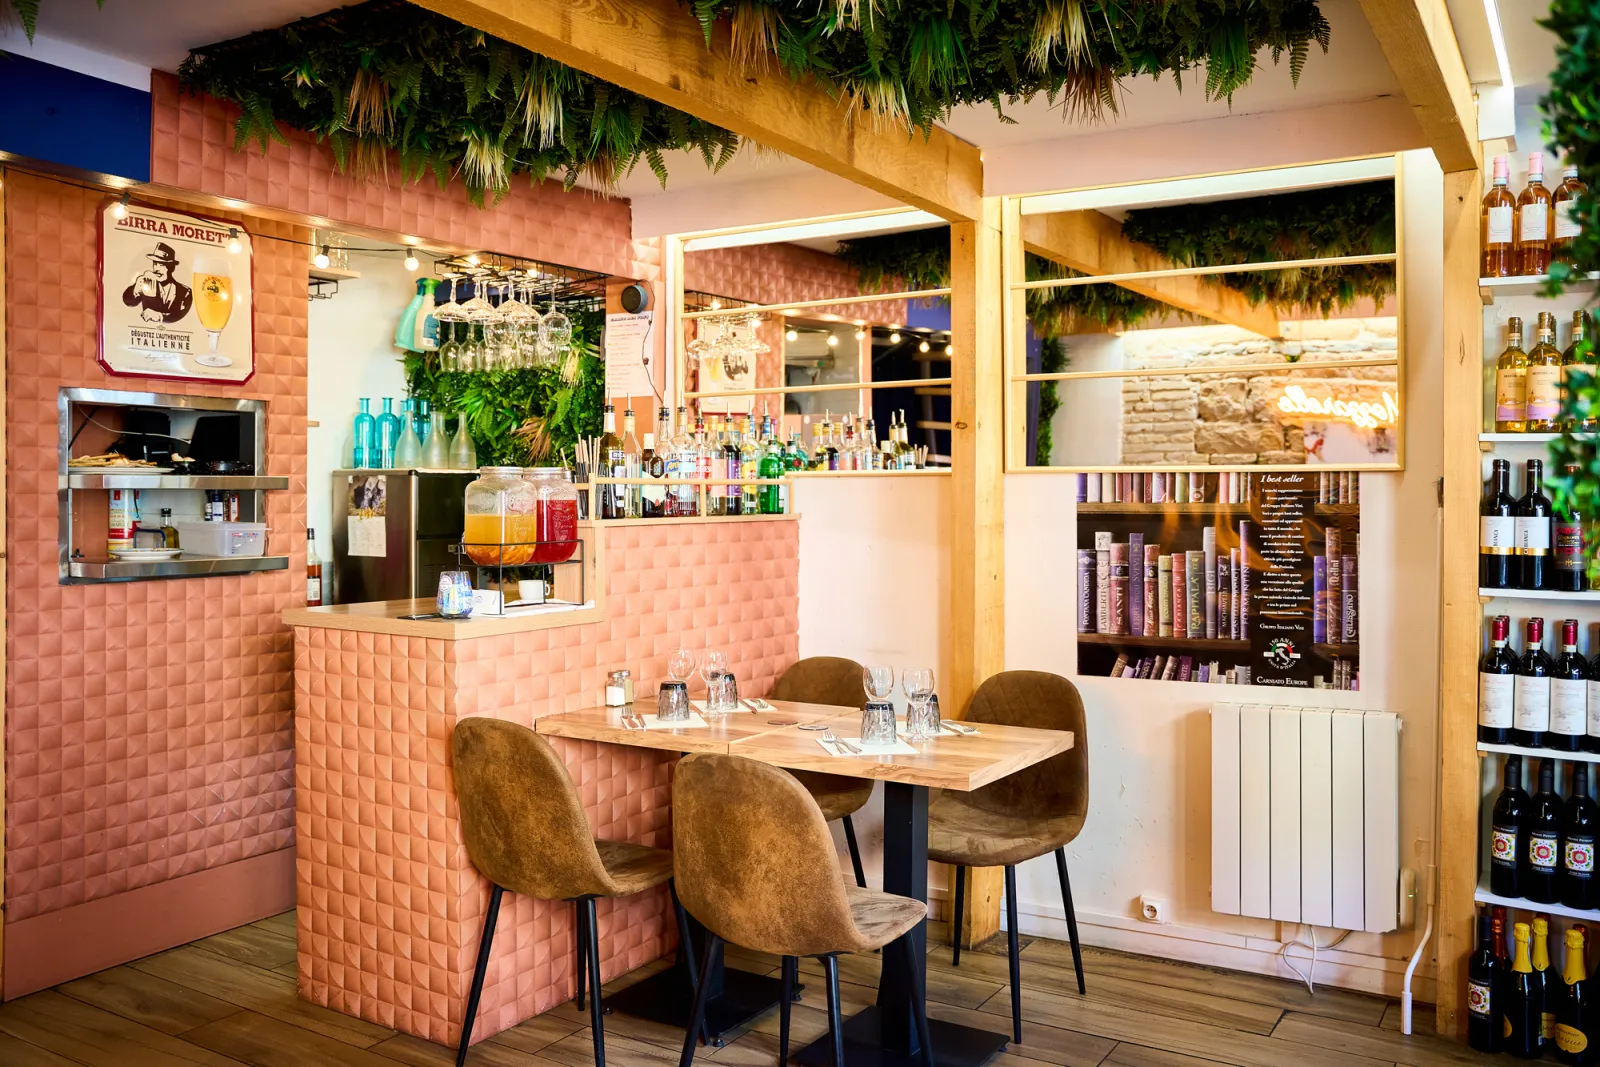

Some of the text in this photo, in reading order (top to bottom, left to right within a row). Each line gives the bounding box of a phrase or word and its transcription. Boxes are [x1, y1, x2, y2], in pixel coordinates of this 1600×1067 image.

[130, 329, 155, 339] DÉGUSTEZ
[131, 337, 190, 350] ITALIENNE
[1266, 474, 1282, 483] best
[1282, 474, 1304, 483] seller
[1206, 570, 1215, 595] BIGI
[1242, 562, 1250, 625] FORMENTINI
[1082, 571, 1090, 625] FONTANA CANDIDA
[1114, 586, 1123, 625] SANTI
